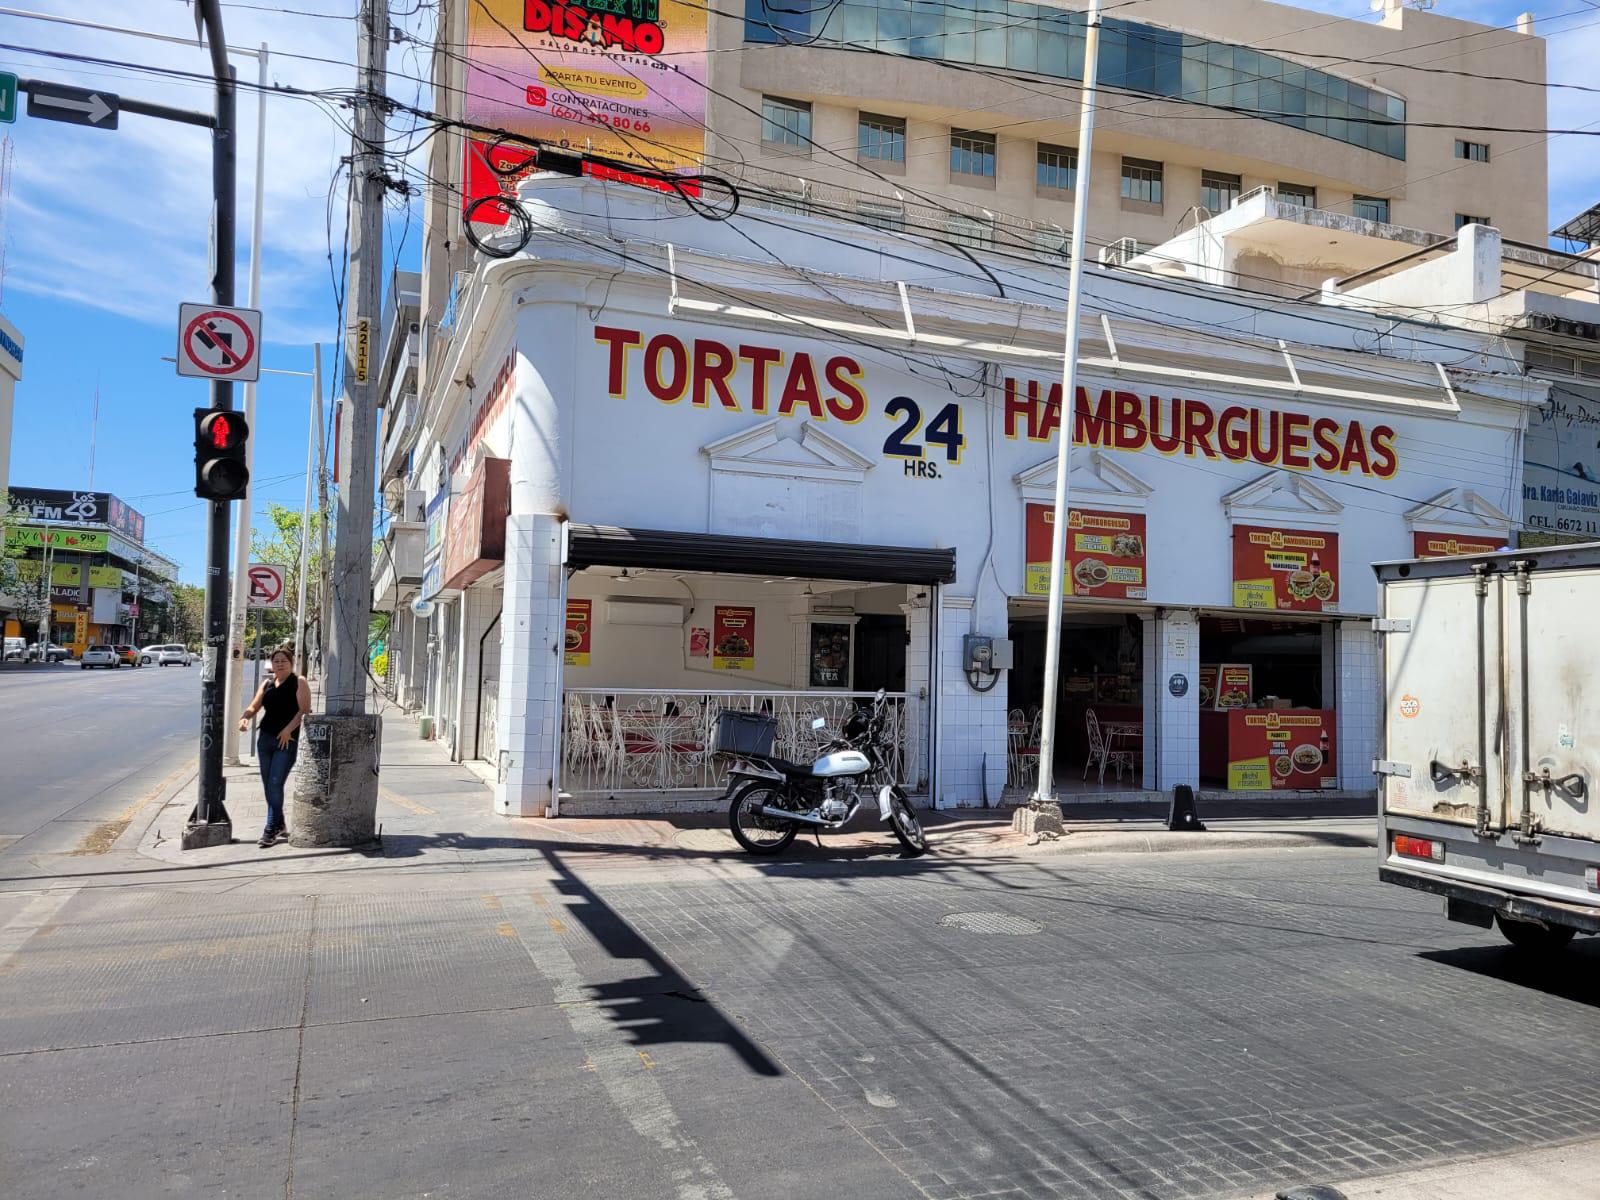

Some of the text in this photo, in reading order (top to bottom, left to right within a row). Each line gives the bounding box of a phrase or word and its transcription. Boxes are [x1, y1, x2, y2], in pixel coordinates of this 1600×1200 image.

[545, 71, 637, 90] APARTA TU EVENTO
[551, 104, 583, 122] (667)
[613, 117, 630, 129] 80
[633, 121, 651, 133] 66
[358, 321, 368, 381] 22115
[593, 325, 867, 425] TORTAS
[882, 396, 967, 465] 24
[1003, 377, 1399, 480] HAMBURGUESAS
[903, 458, 943, 480] HRS.
[1540, 485, 1565, 504] Karla
[1566, 488, 1598, 507] Galaviz
[32, 505, 62, 519] FM
[1529, 514, 1597, 533] CEL. 6672 11
[80, 533, 97, 541] 919
[1272, 532, 1281, 542] 24
[250, 574, 271, 597] E
[1268, 714, 1278, 722] 24
